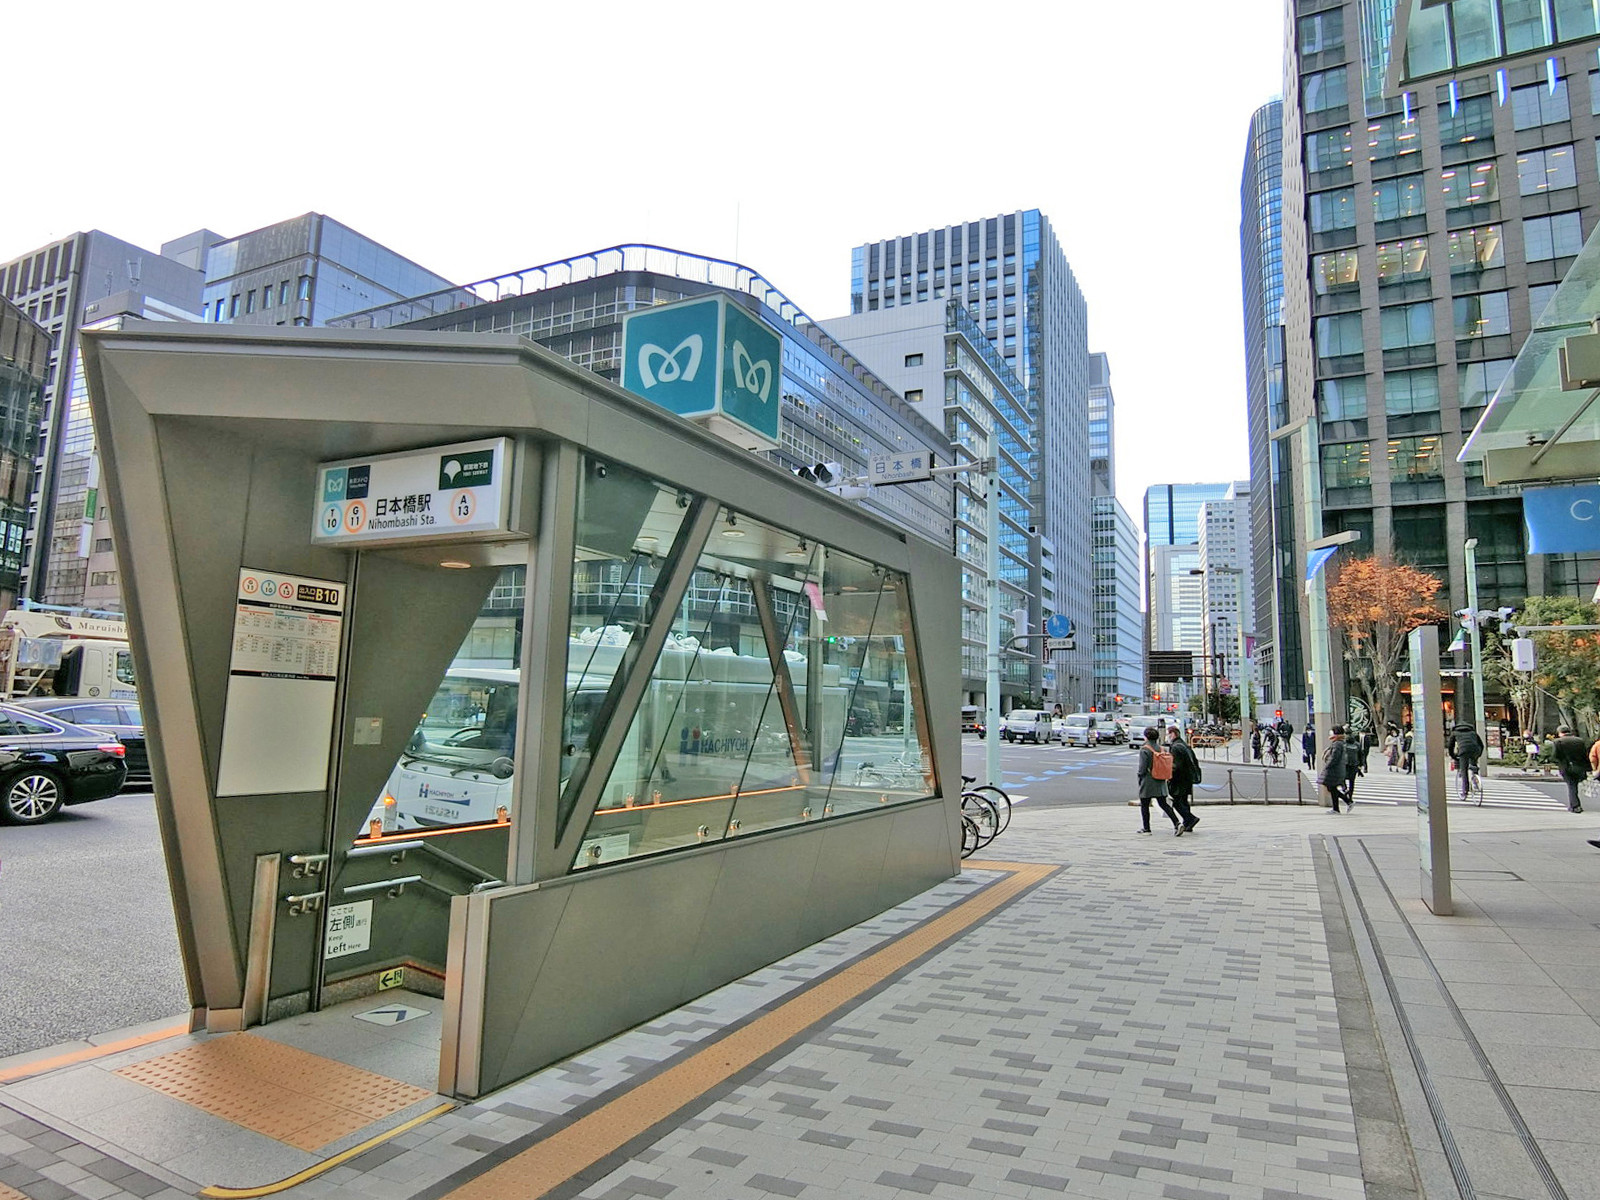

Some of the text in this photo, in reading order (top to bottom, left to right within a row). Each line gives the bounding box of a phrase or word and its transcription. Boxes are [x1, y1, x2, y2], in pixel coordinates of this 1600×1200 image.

[876, 457, 922, 474] 日本橋
[376, 494, 431, 516] 日本橋駅
[460, 495, 467, 504] A
[330, 509, 335, 517] T
[353, 506, 359, 515] G
[458, 505, 469, 516] 13
[1570, 499, 1600, 521] C
[327, 518, 337, 528] 10
[351, 516, 360, 526] 11
[368, 514, 437, 530] Nihombashi Sta.
[316, 588, 338, 604] B10
[425, 805, 460, 819] ISUZU
[328, 942, 347, 955] Left
